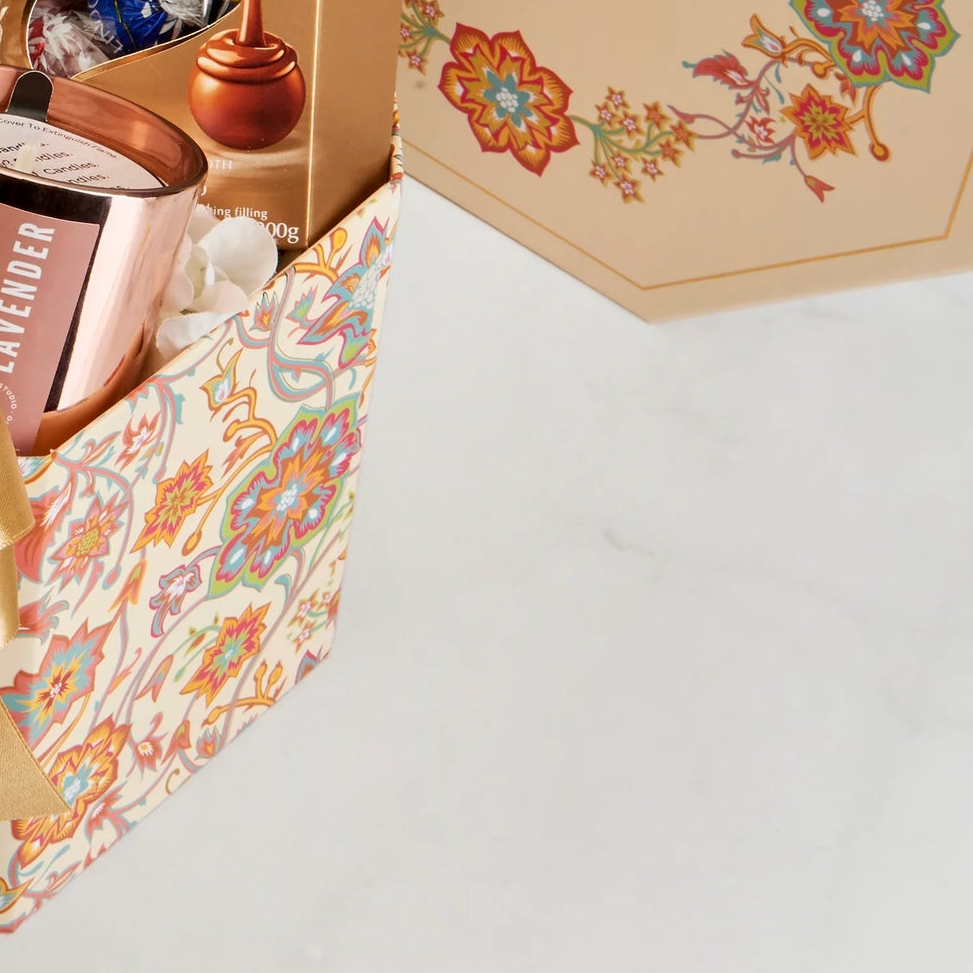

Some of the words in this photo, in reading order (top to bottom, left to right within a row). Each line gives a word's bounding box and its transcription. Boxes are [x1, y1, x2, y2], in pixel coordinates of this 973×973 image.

[43, 127, 91, 146] Extinguish
[235, 206, 268, 220] filling
[259, 222, 300, 244] 00g
